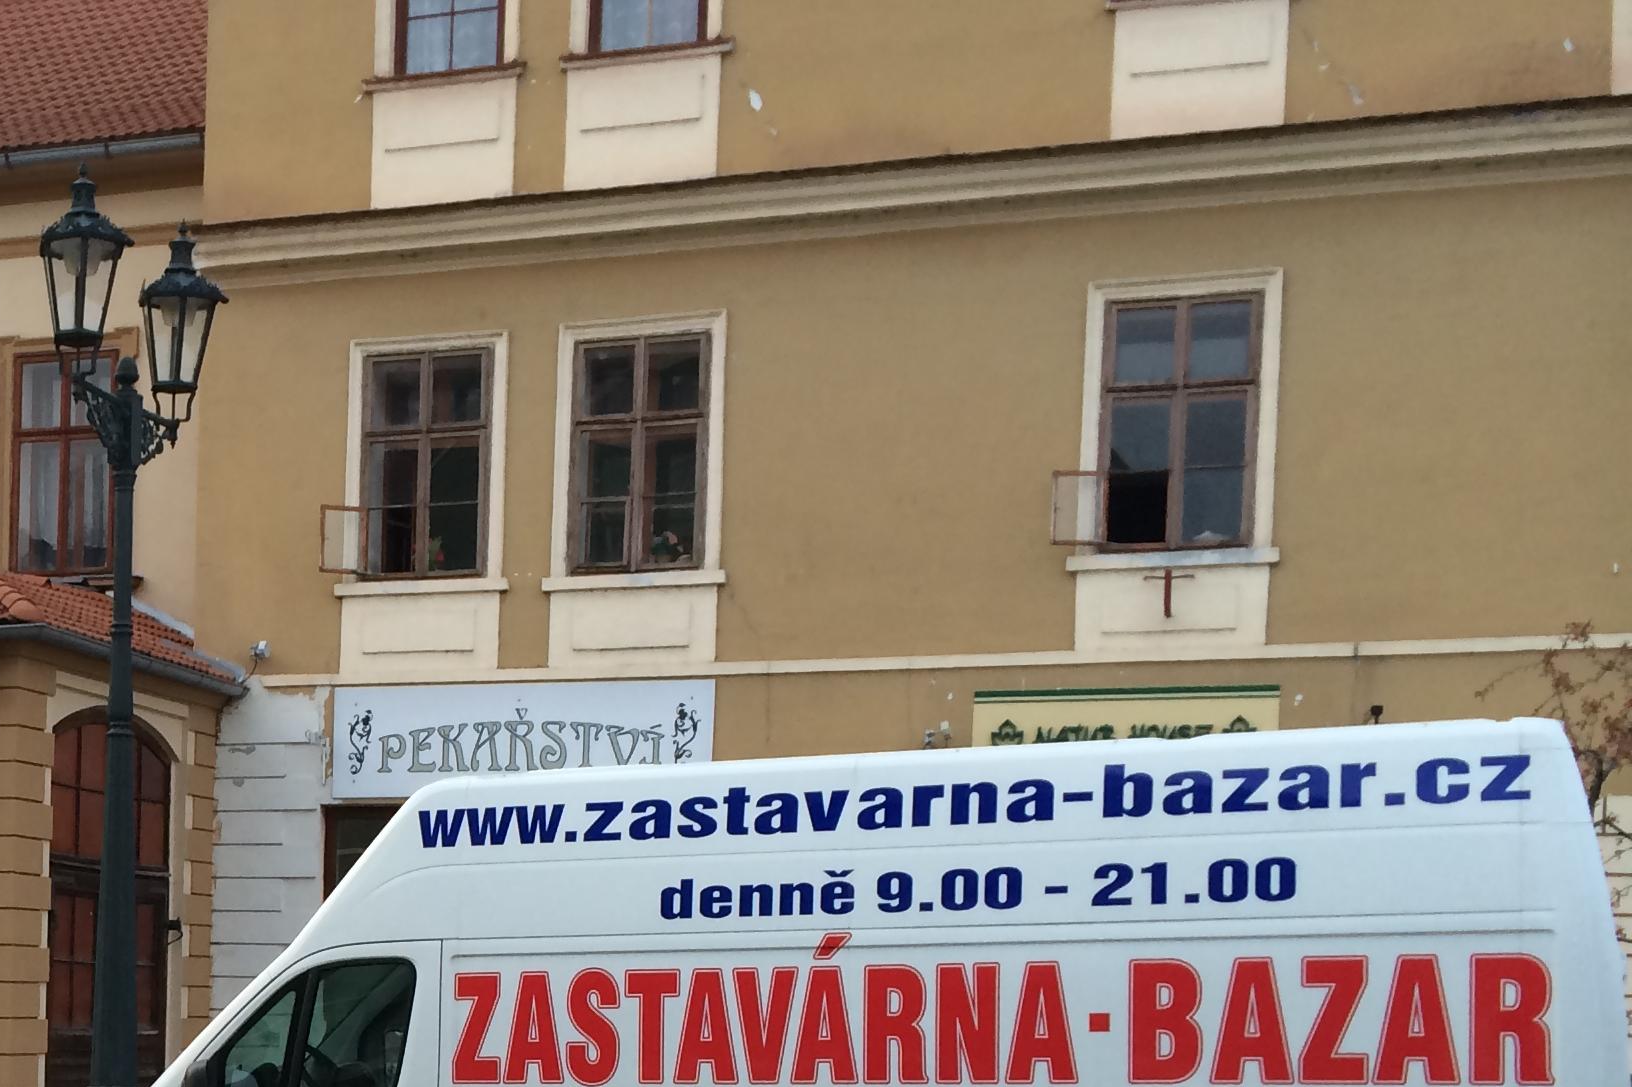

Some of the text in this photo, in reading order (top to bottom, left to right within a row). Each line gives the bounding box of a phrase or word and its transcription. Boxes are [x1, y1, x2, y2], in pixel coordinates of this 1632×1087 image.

[376, 707, 666, 773] PEKAŘSTVÍ
[418, 753, 1531, 849] www.zastavarna-bazar.cz
[660, 869, 855, 920] denně
[876, 866, 1023, 913] 9.00
[1091, 857, 1296, 907] 21.00
